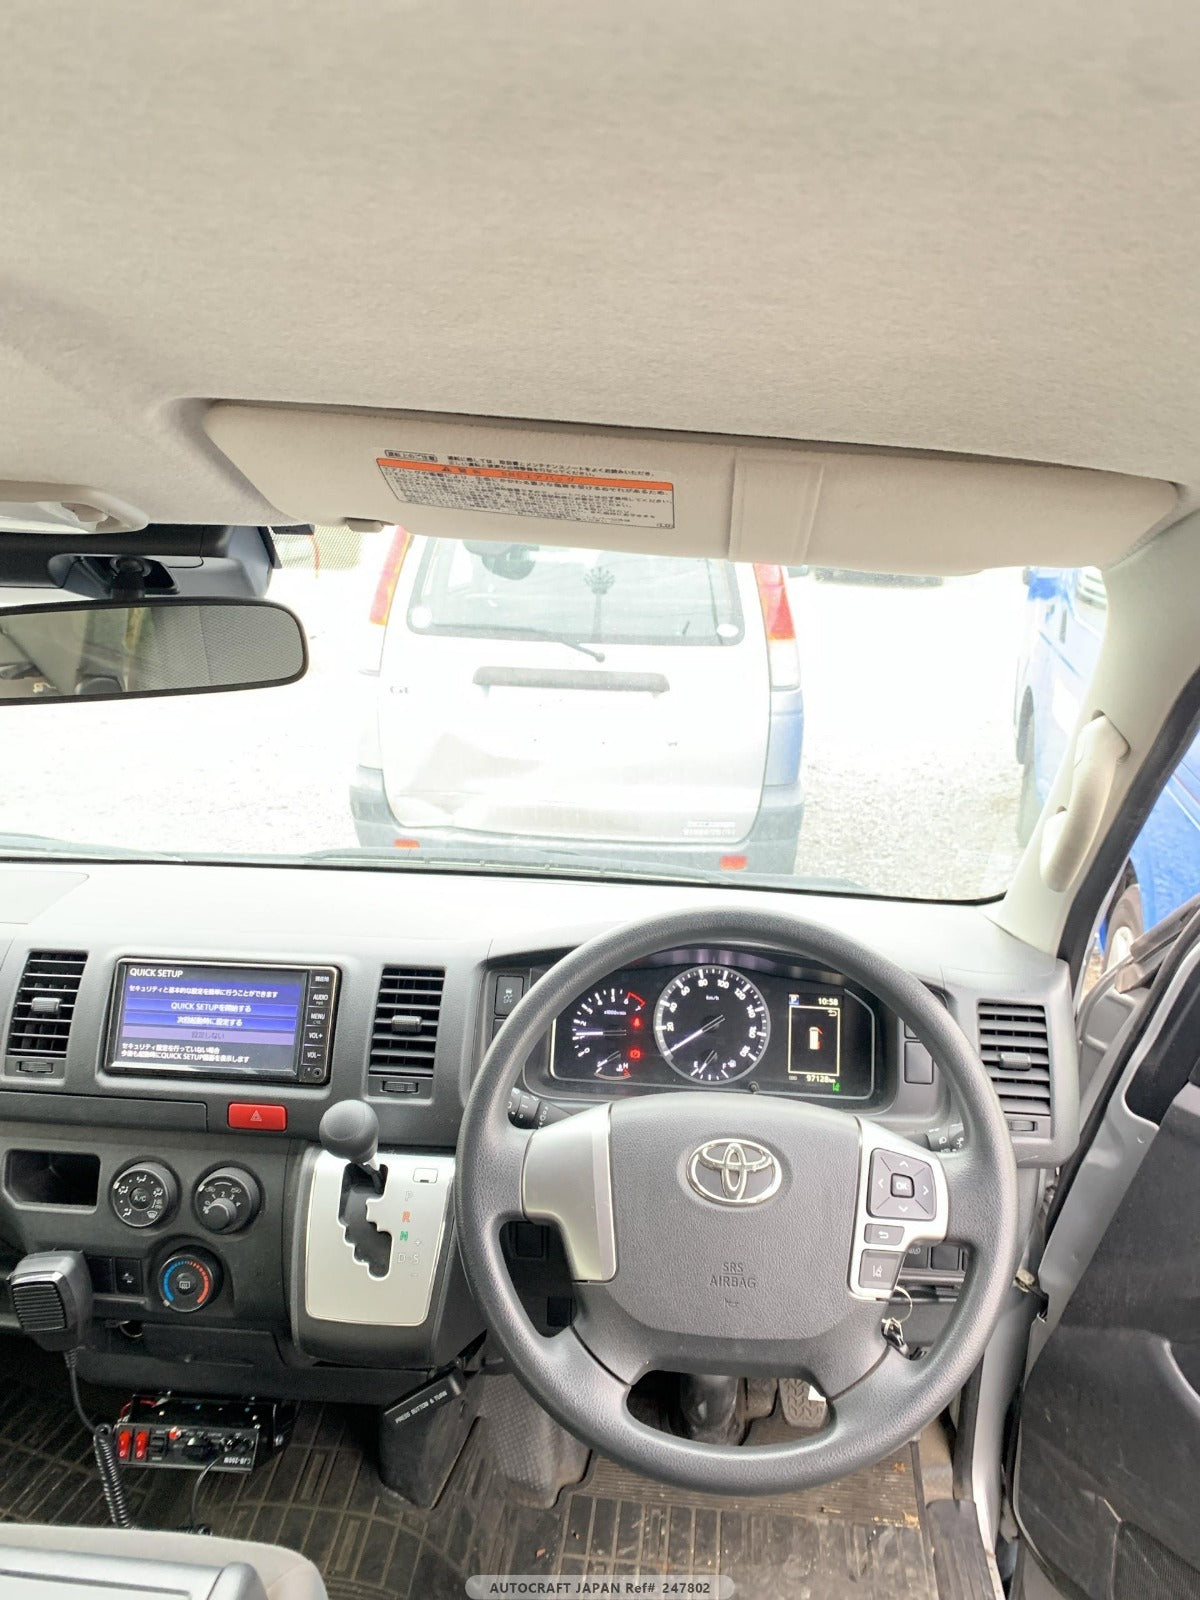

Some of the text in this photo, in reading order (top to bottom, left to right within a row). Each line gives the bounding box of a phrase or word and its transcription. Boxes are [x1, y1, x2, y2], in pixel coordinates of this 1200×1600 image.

[129, 968, 183, 978] QUICK SETUP
[698, 979, 708, 987] 80
[717, 979, 729, 989] 100
[681, 986, 690, 996] 60
[734, 988, 746, 1000] 120
[171, 1002, 195, 1010] QUICK
[818, 997, 838, 1006] 10:58
[669, 1002, 677, 1013] 40
[746, 1004, 756, 1018] 140
[666, 1022, 674, 1031] 20
[896, 1182, 908, 1190] OK
[405, 1191, 413, 1201] P
[402, 1211, 410, 1222] R
[400, 1231, 408, 1241] N
[398, 1254, 420, 1264] D S
[723, 1261, 743, 1273] SRS
[710, 1275, 756, 1288] AIRBAG
